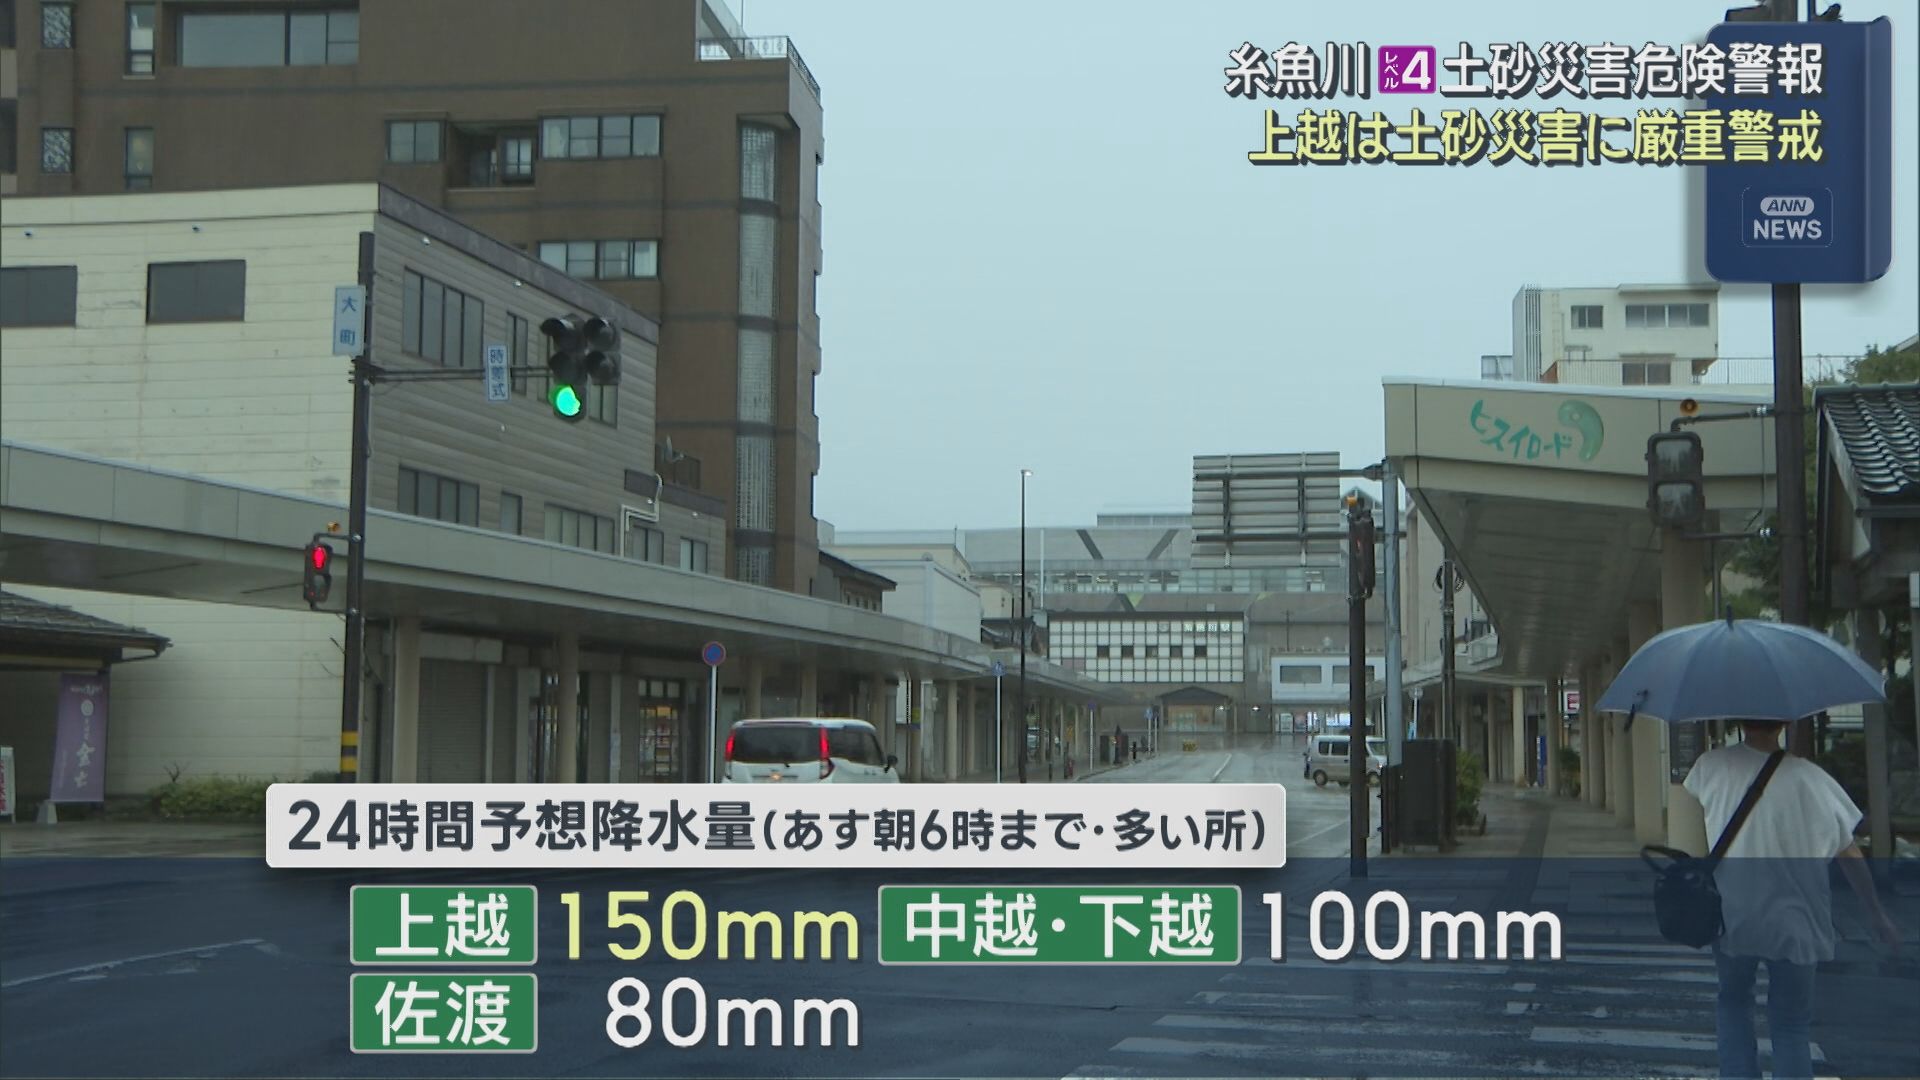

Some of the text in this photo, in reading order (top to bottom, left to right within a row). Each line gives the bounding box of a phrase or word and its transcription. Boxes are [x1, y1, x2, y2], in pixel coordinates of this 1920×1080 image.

[340, 296, 358, 346] 大町
[1470, 399, 1572, 459] ヒスイロード
